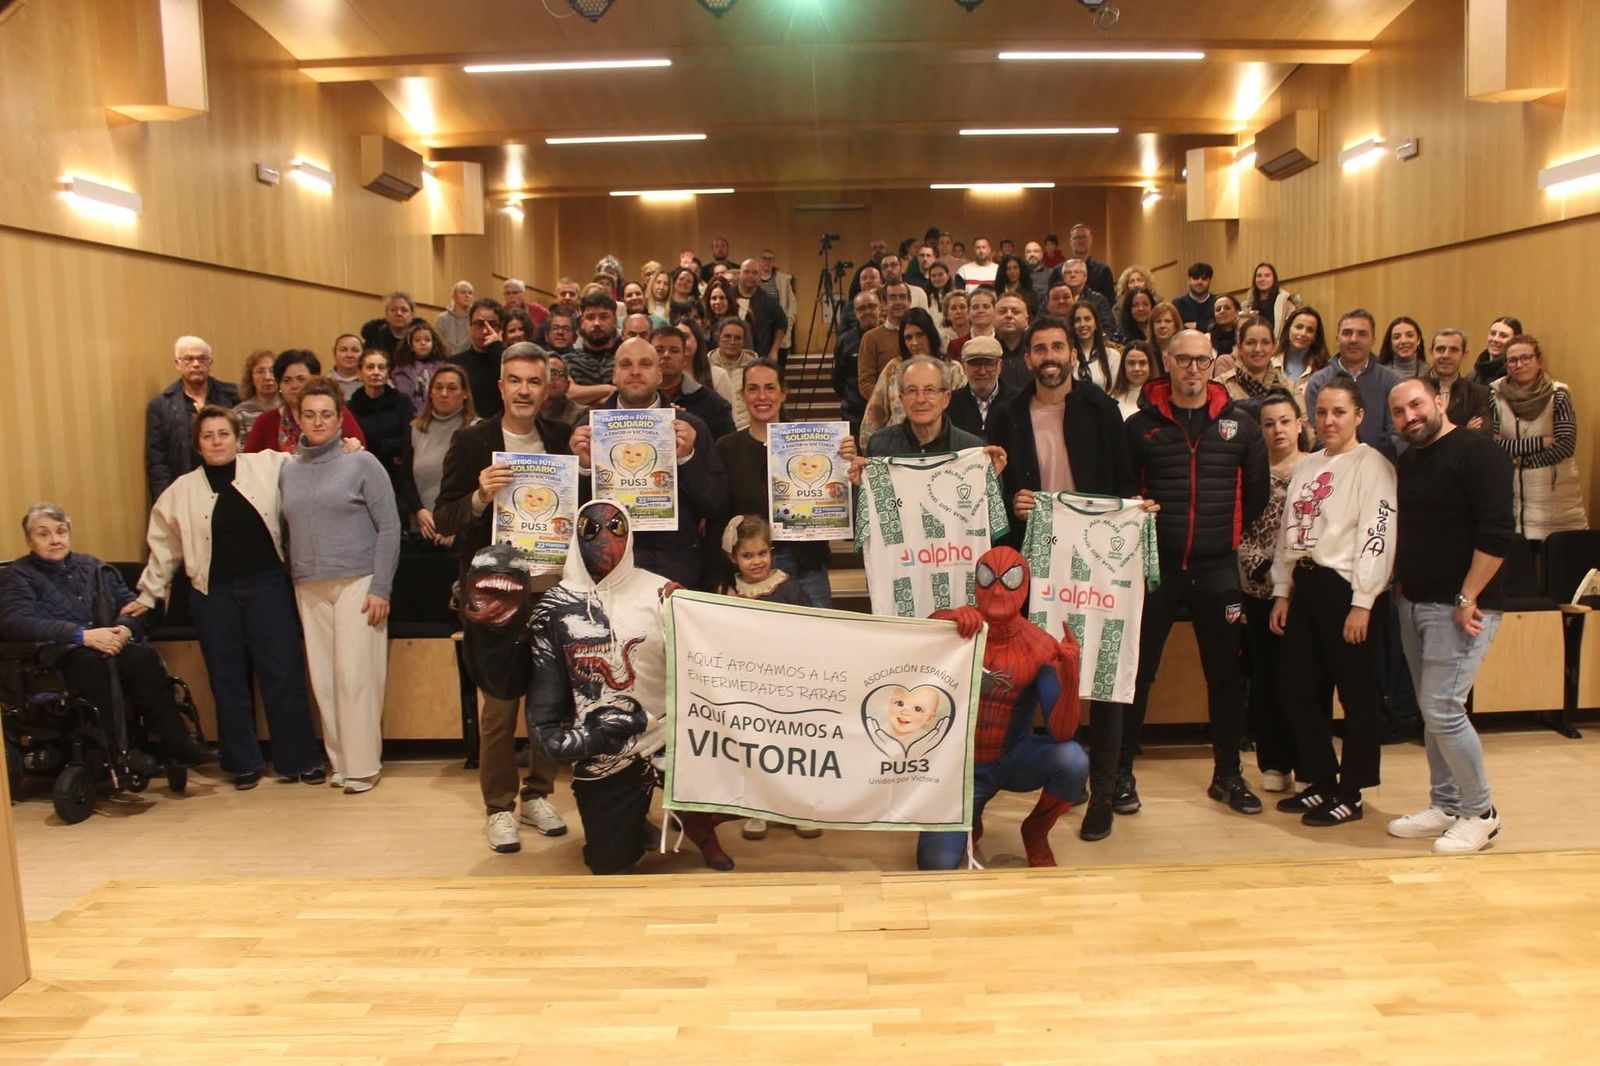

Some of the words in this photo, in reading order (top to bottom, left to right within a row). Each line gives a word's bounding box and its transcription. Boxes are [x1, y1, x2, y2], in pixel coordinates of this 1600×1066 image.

[608, 420, 654, 429] SOLIDARIO
[785, 433, 830, 442] SOLIDARIO
[510, 465, 556, 474] SOLIDARIO
[521, 522, 548, 531] PUS3
[918, 542, 972, 567] alpha
[1059, 585, 1114, 608] alpha
[687, 652, 722, 669] AQUÍ
[727, 659, 806, 679] APOYAMOS
[810, 669, 819, 680] A
[823, 670, 848, 683] LAS
[864, 663, 918, 687] ASOCIACIÓN
[920, 665, 960, 690] ESPAÑOLA
[688, 669, 794, 698] ENFERMEDADES
[797, 686, 848, 702] RARAS
[730, 715, 827, 738] APOYAMOS
[832, 725, 844, 740] A
[688, 728, 842, 779] VICTORIA
[880, 758, 930, 775] PUS3
